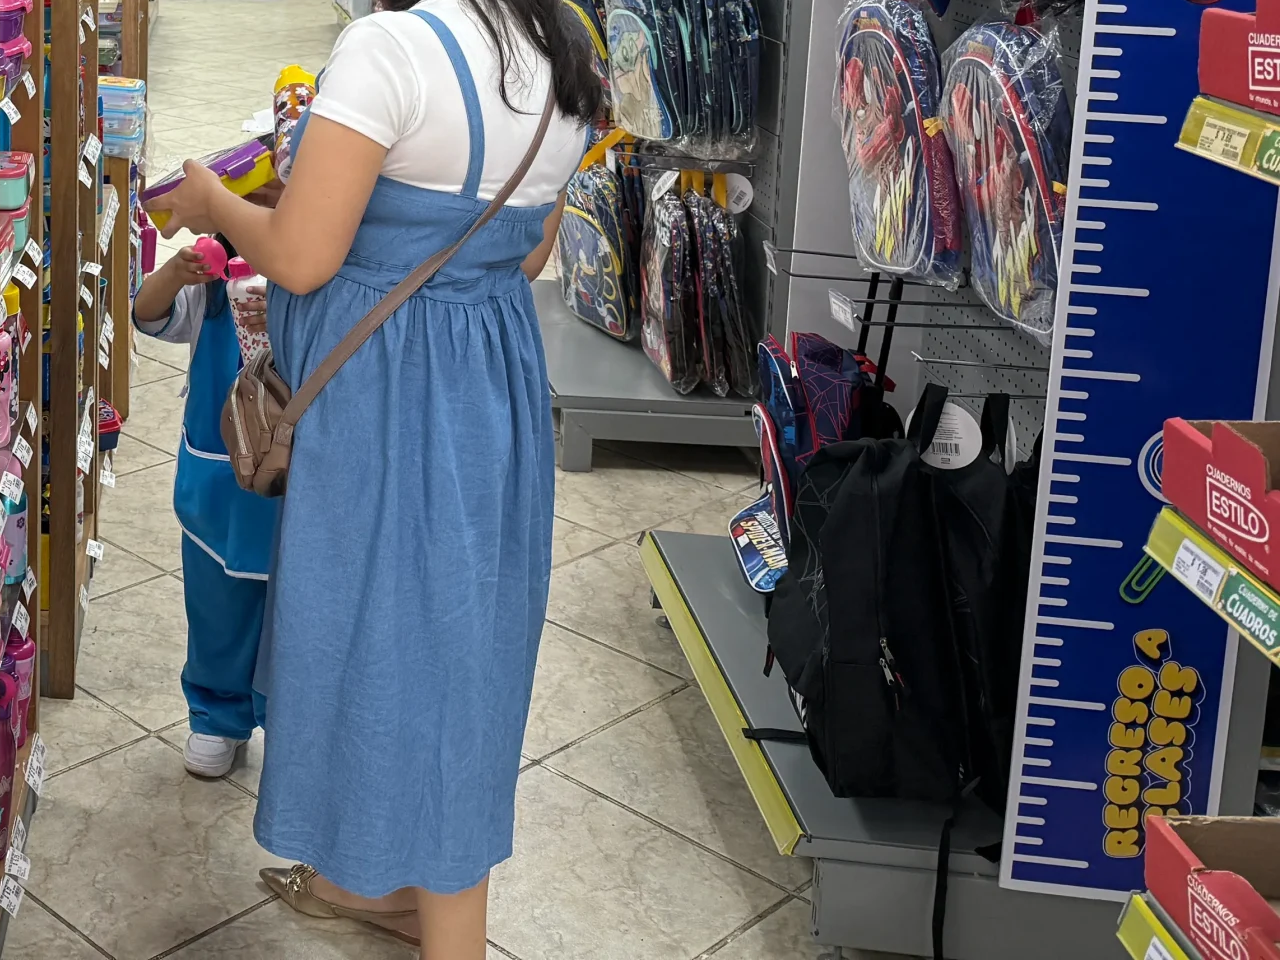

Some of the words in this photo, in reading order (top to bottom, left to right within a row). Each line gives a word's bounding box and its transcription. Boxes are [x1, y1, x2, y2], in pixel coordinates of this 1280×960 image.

[1206, 463, 1252, 500] CUADERNOS
[1211, 493, 1260, 536] ESTILO
[1134, 629, 1169, 660] A
[1225, 593, 1278, 647] CUADROS
[1103, 665, 1156, 858] REGRESO
[1186, 874, 1240, 927] CUADERNOS
[1193, 902, 1241, 960] ESTILO
